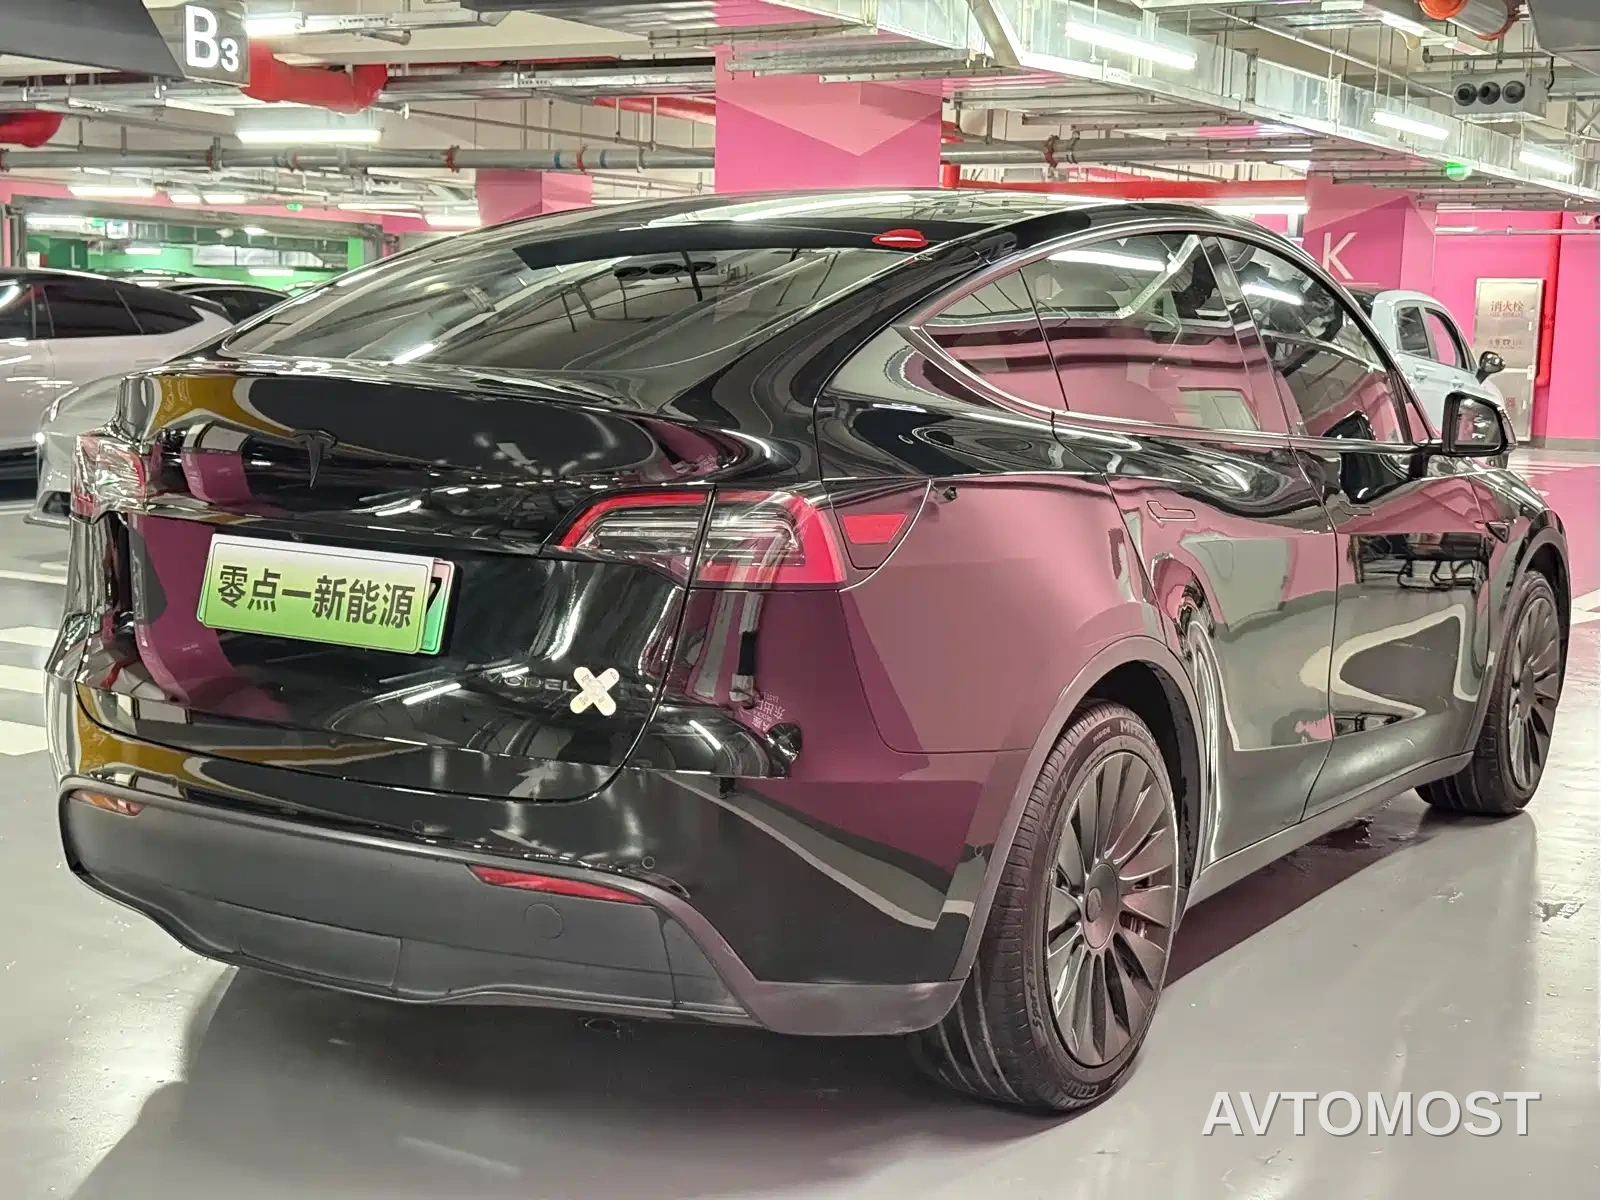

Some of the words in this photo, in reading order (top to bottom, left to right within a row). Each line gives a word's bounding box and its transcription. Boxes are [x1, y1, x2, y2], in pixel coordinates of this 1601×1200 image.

[185, 5, 239, 72] B3
[1322, 231, 1358, 280] K
[1490, 300, 1524, 312] 消火栓
[217, 564, 416, 629] 零点一新能源
